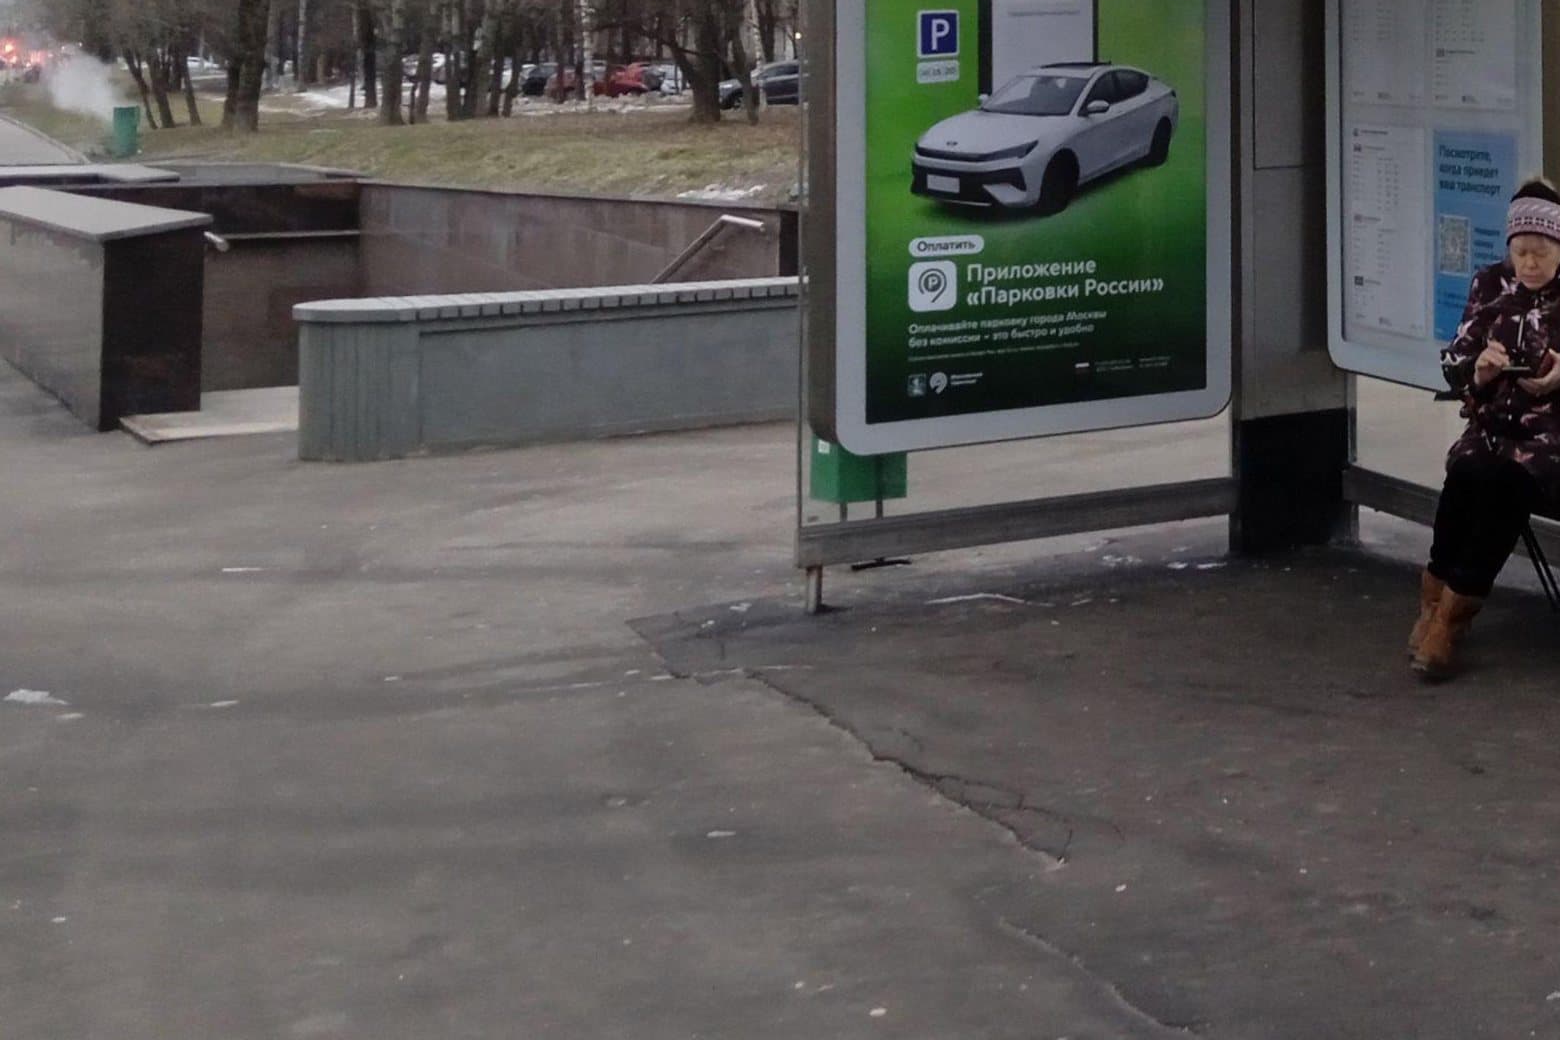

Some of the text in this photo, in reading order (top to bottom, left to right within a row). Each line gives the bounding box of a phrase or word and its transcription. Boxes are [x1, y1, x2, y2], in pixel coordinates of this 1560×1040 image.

[931, 18, 950, 51] P
[917, 240, 975, 253] Оплатить
[967, 260, 1096, 284] Приложение
[967, 278, 1164, 307] «Парковки России»
[1030, 313, 1064, 326] города
[1066, 310, 1107, 321] Москвы
[908, 336, 928, 348] без
[1010, 327, 1048, 340] быстро
[1058, 323, 1095, 336] удобно
